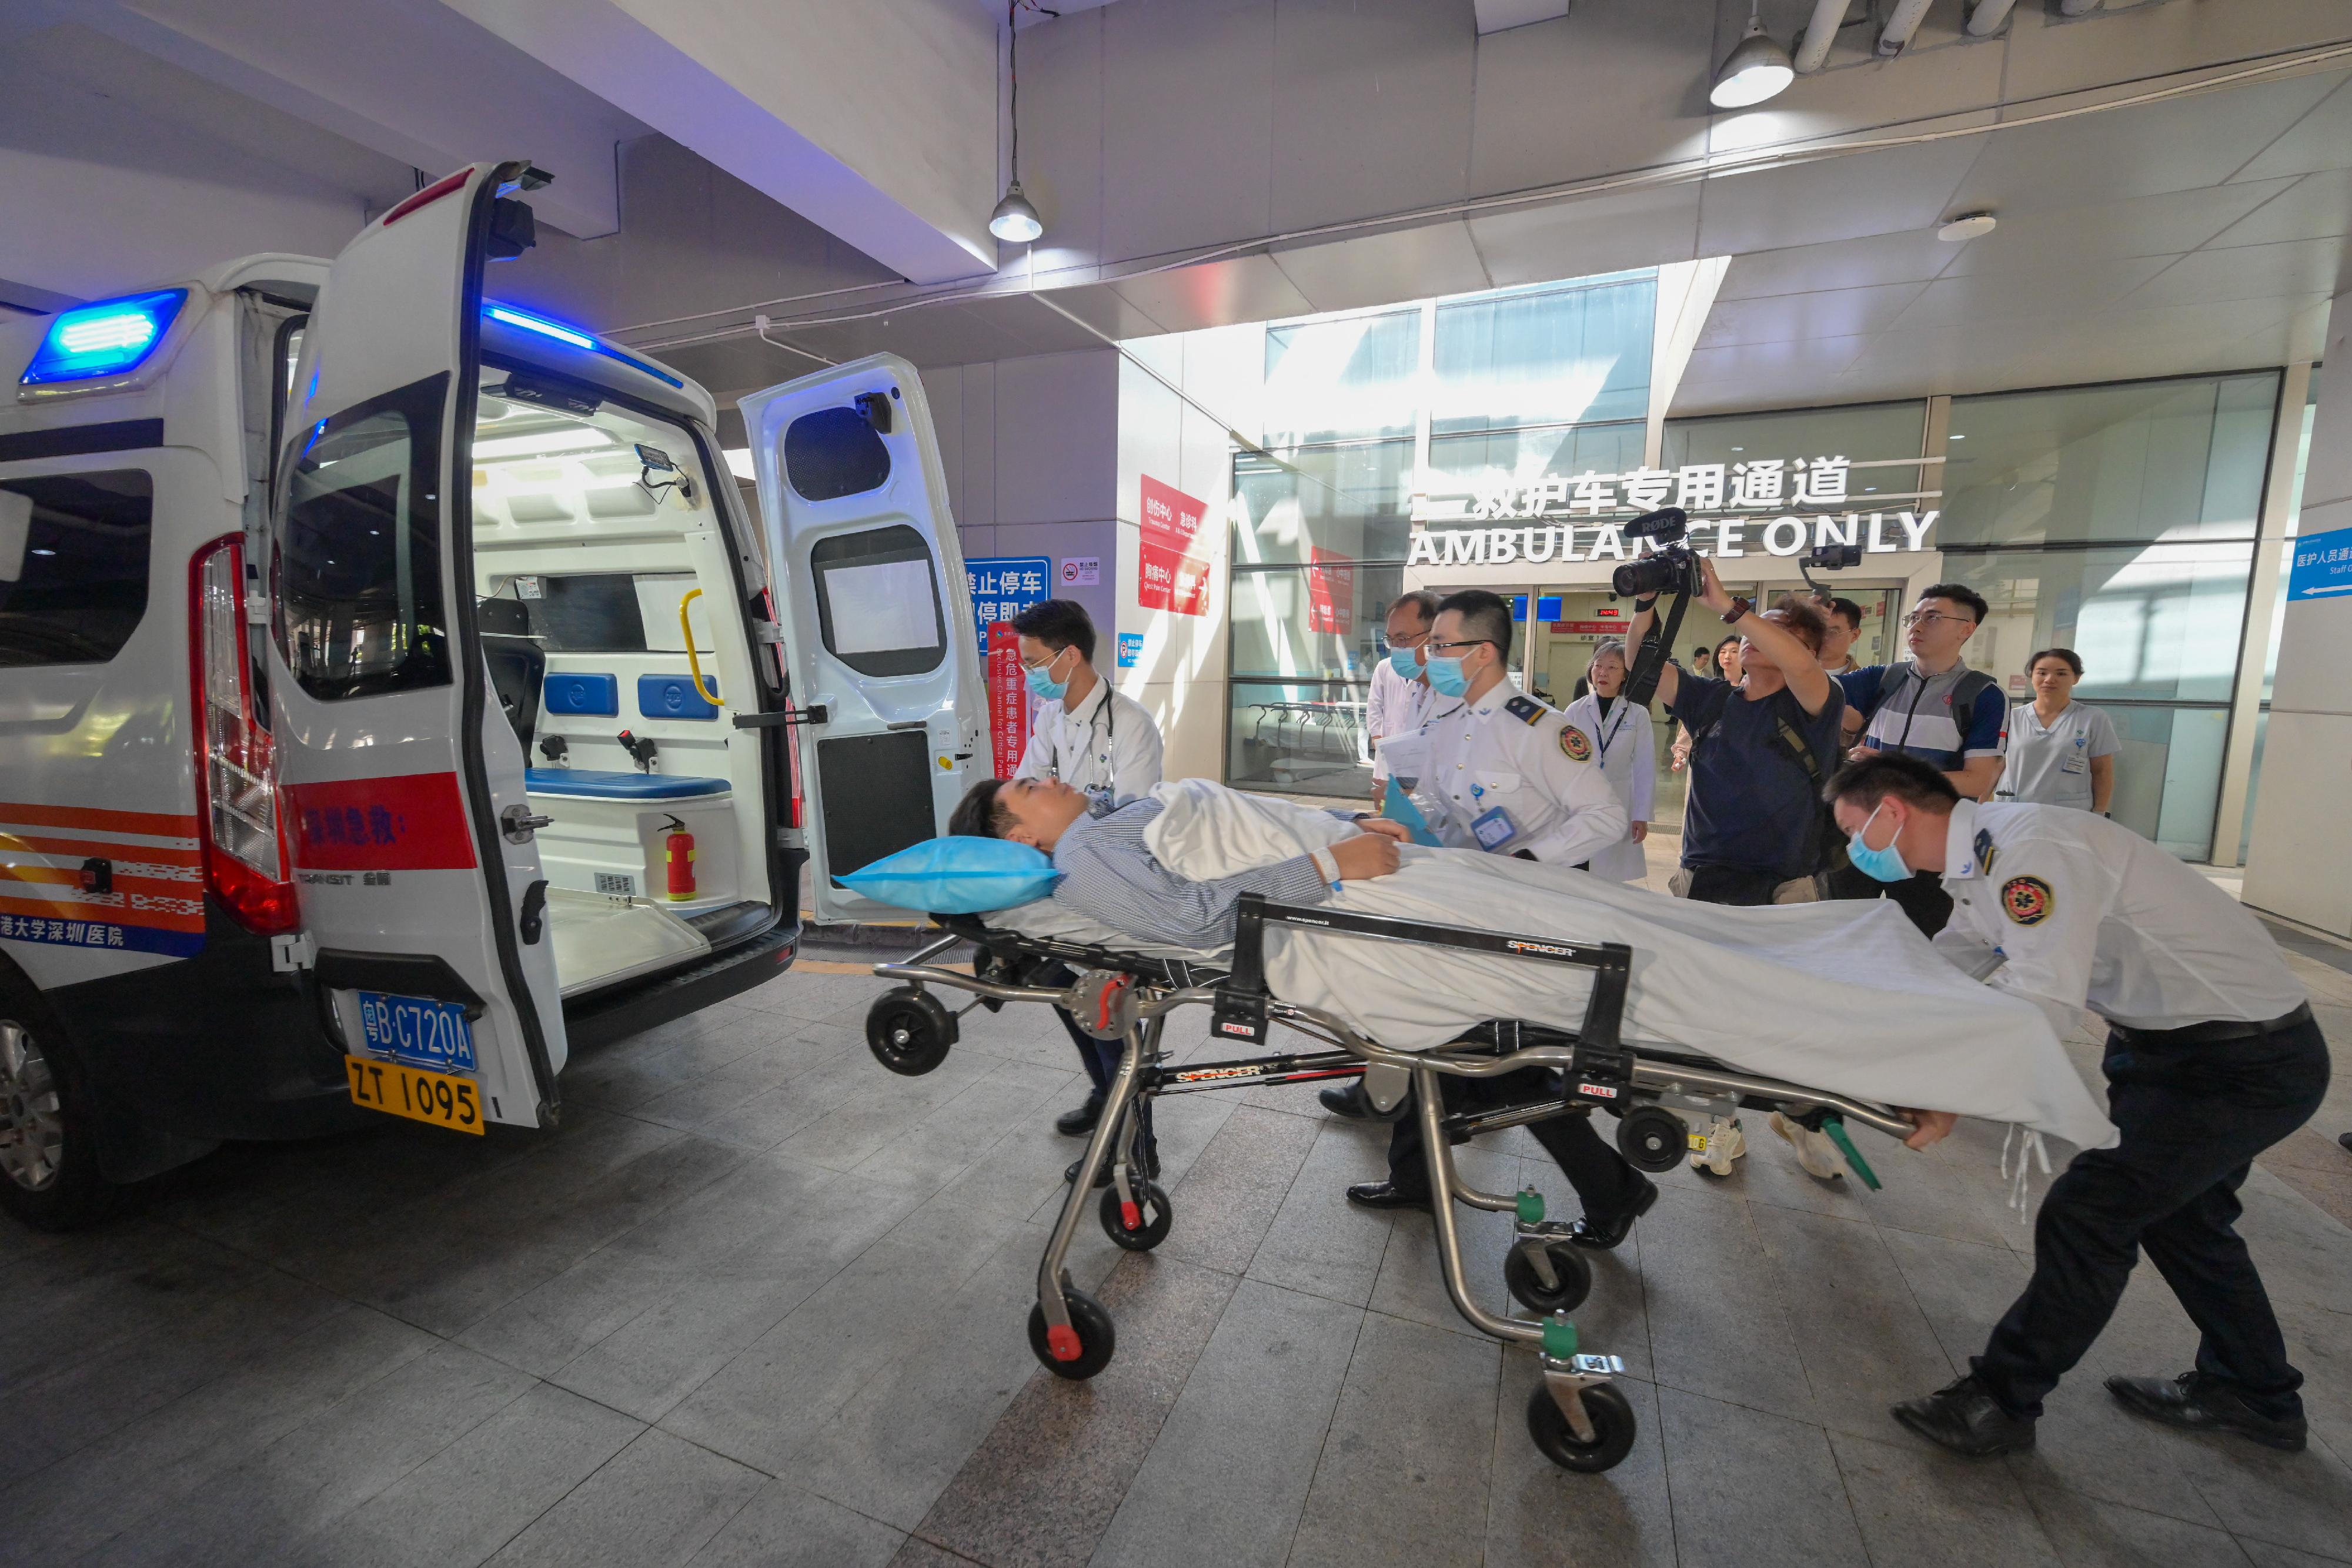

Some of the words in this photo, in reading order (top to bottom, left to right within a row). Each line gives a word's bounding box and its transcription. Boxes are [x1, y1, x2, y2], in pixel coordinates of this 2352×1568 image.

[1472, 456, 1850, 521] 救护车专用通道
[1147, 497, 1172, 521] 创伤中心
[1180, 511, 1197, 532] 急诊科
[1642, 516, 1676, 533] RØDE
[1764, 511, 1939, 556] ONLY
[2297, 547, 2352, 567] 医护人员通
[1145, 563, 1171, 584] 胸痛中心
[2330, 564, 2347, 574] Staff
[1128, 649, 1141, 657] 即停即
[1006, 648, 1018, 780] 急危重症患者专用通
[1285, 916, 1329, 925] www.spencer.it
[0, 915, 124, 947] 港大学深圳医院
[1506, 940, 1575, 957] SPENCER
[1225, 1025, 1251, 1035] PULL
[1177, 1065, 1262, 1083] SPENCER
[351, 1062, 383, 1105] ZT
[401, 1073, 476, 1125] 1095
[1583, 1085, 1613, 1097] PULL
